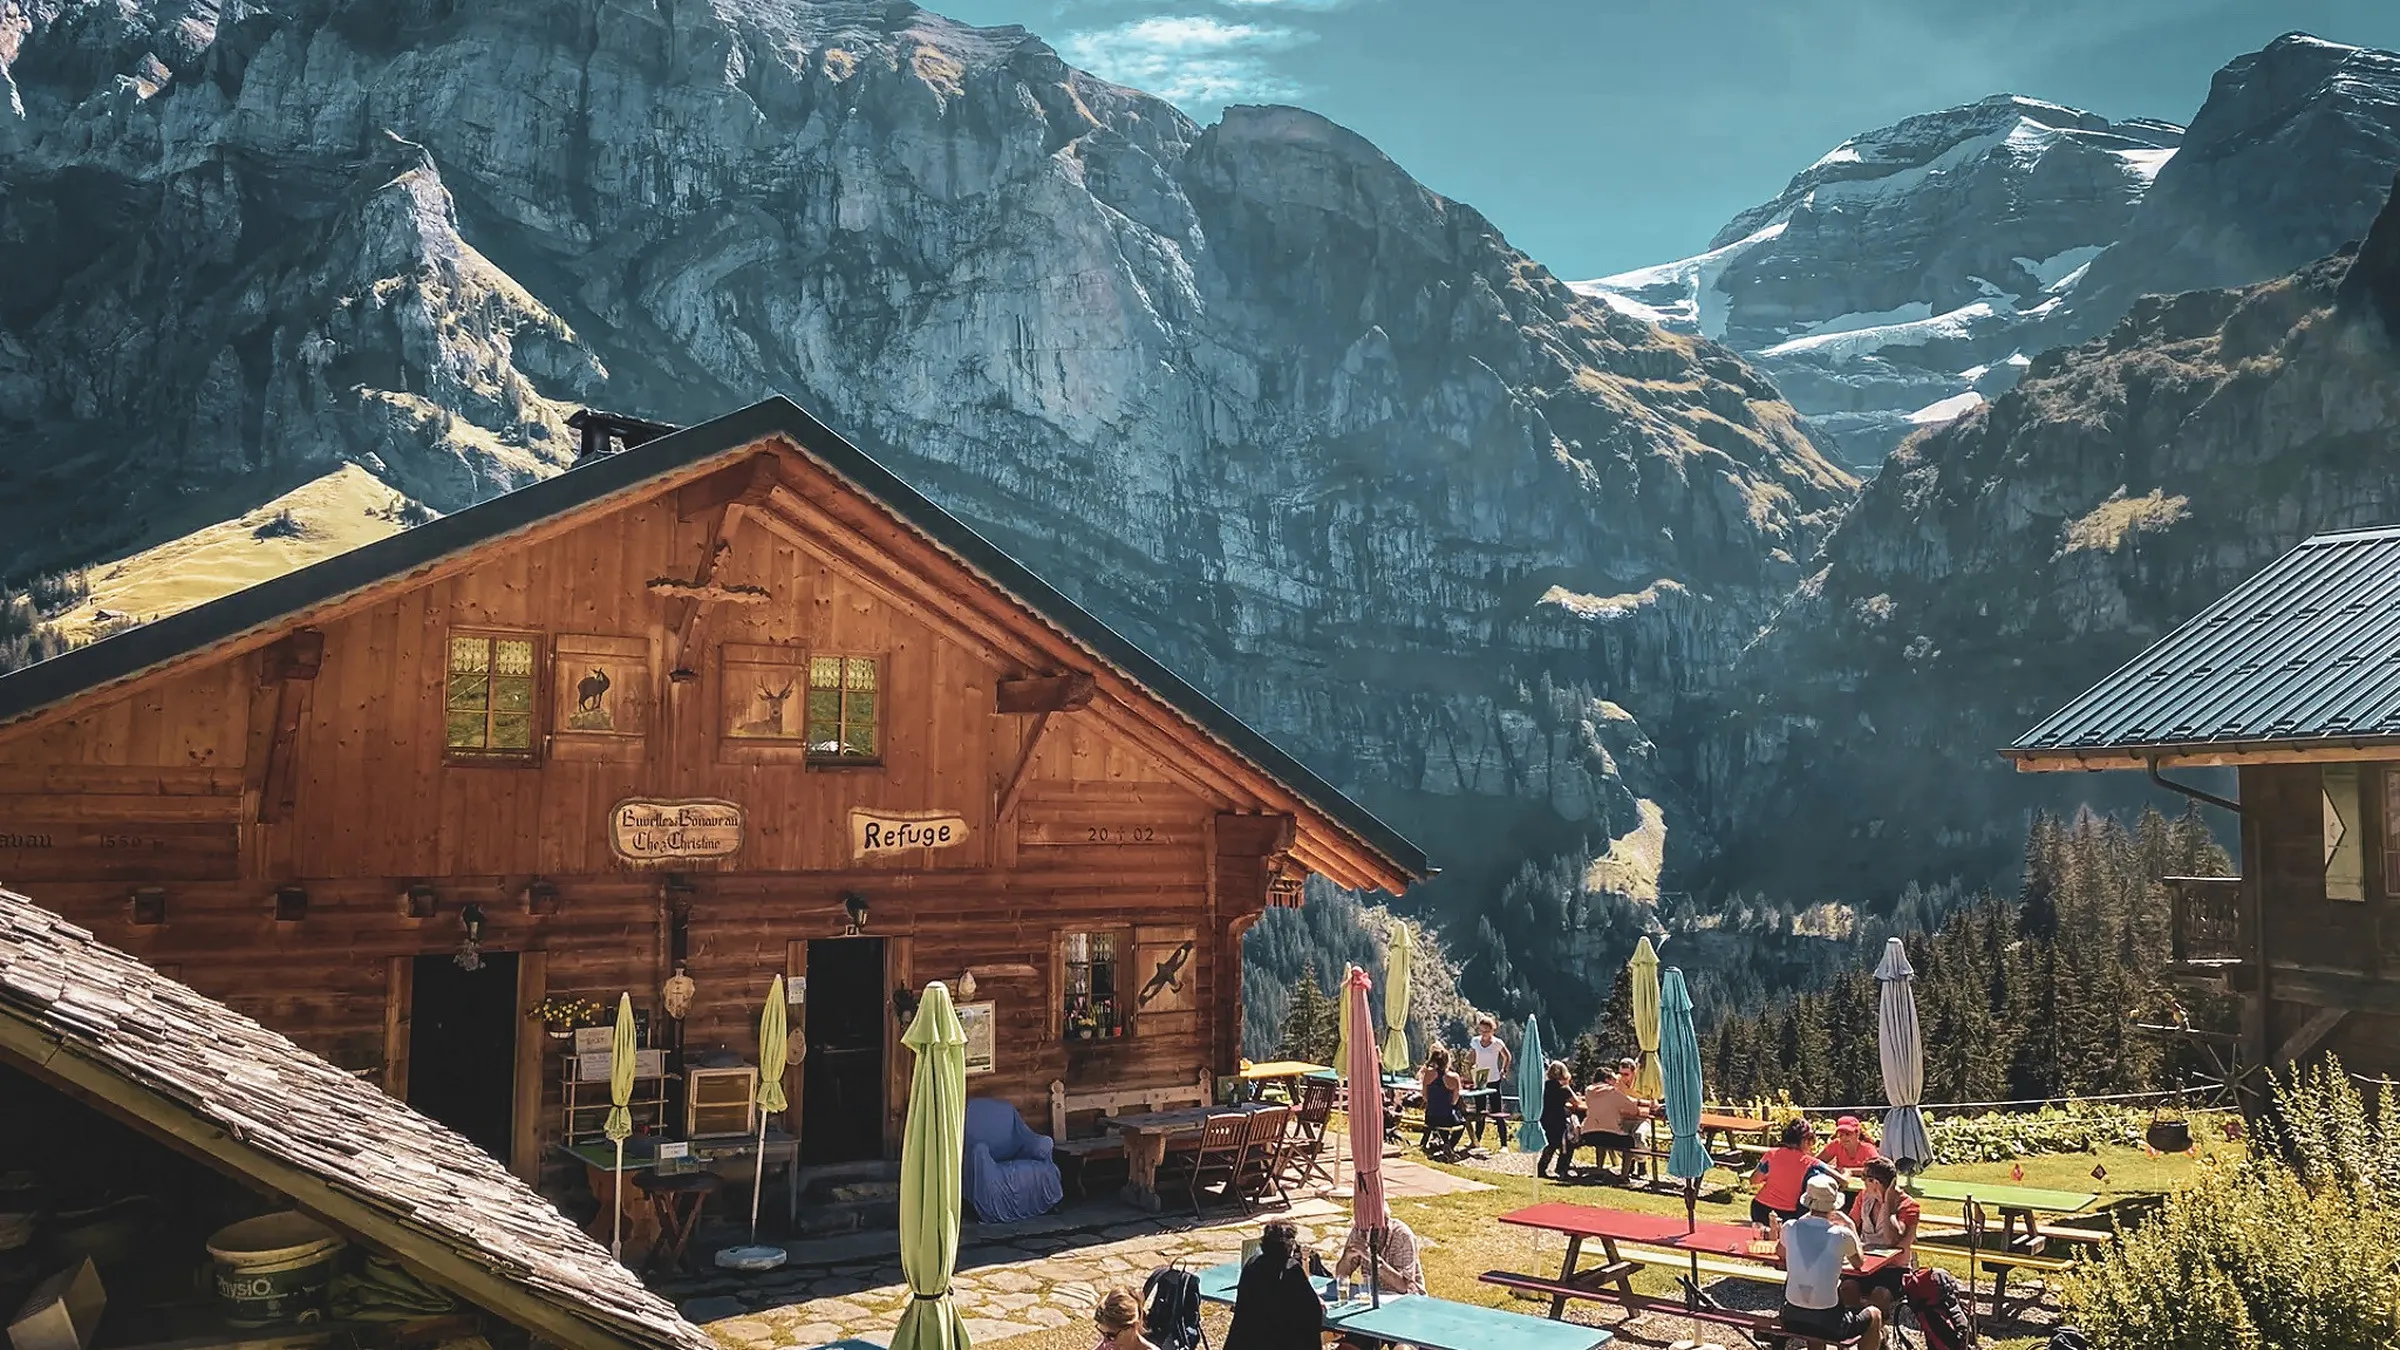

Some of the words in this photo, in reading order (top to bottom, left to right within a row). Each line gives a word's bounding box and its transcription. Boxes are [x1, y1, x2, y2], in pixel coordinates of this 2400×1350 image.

[632, 831, 667, 852] Chez
[667, 831, 720, 852] Christine
[864, 822, 950, 849] Refuge
[1088, 827, 1108, 841] 20
[1134, 827, 1153, 841] 02
